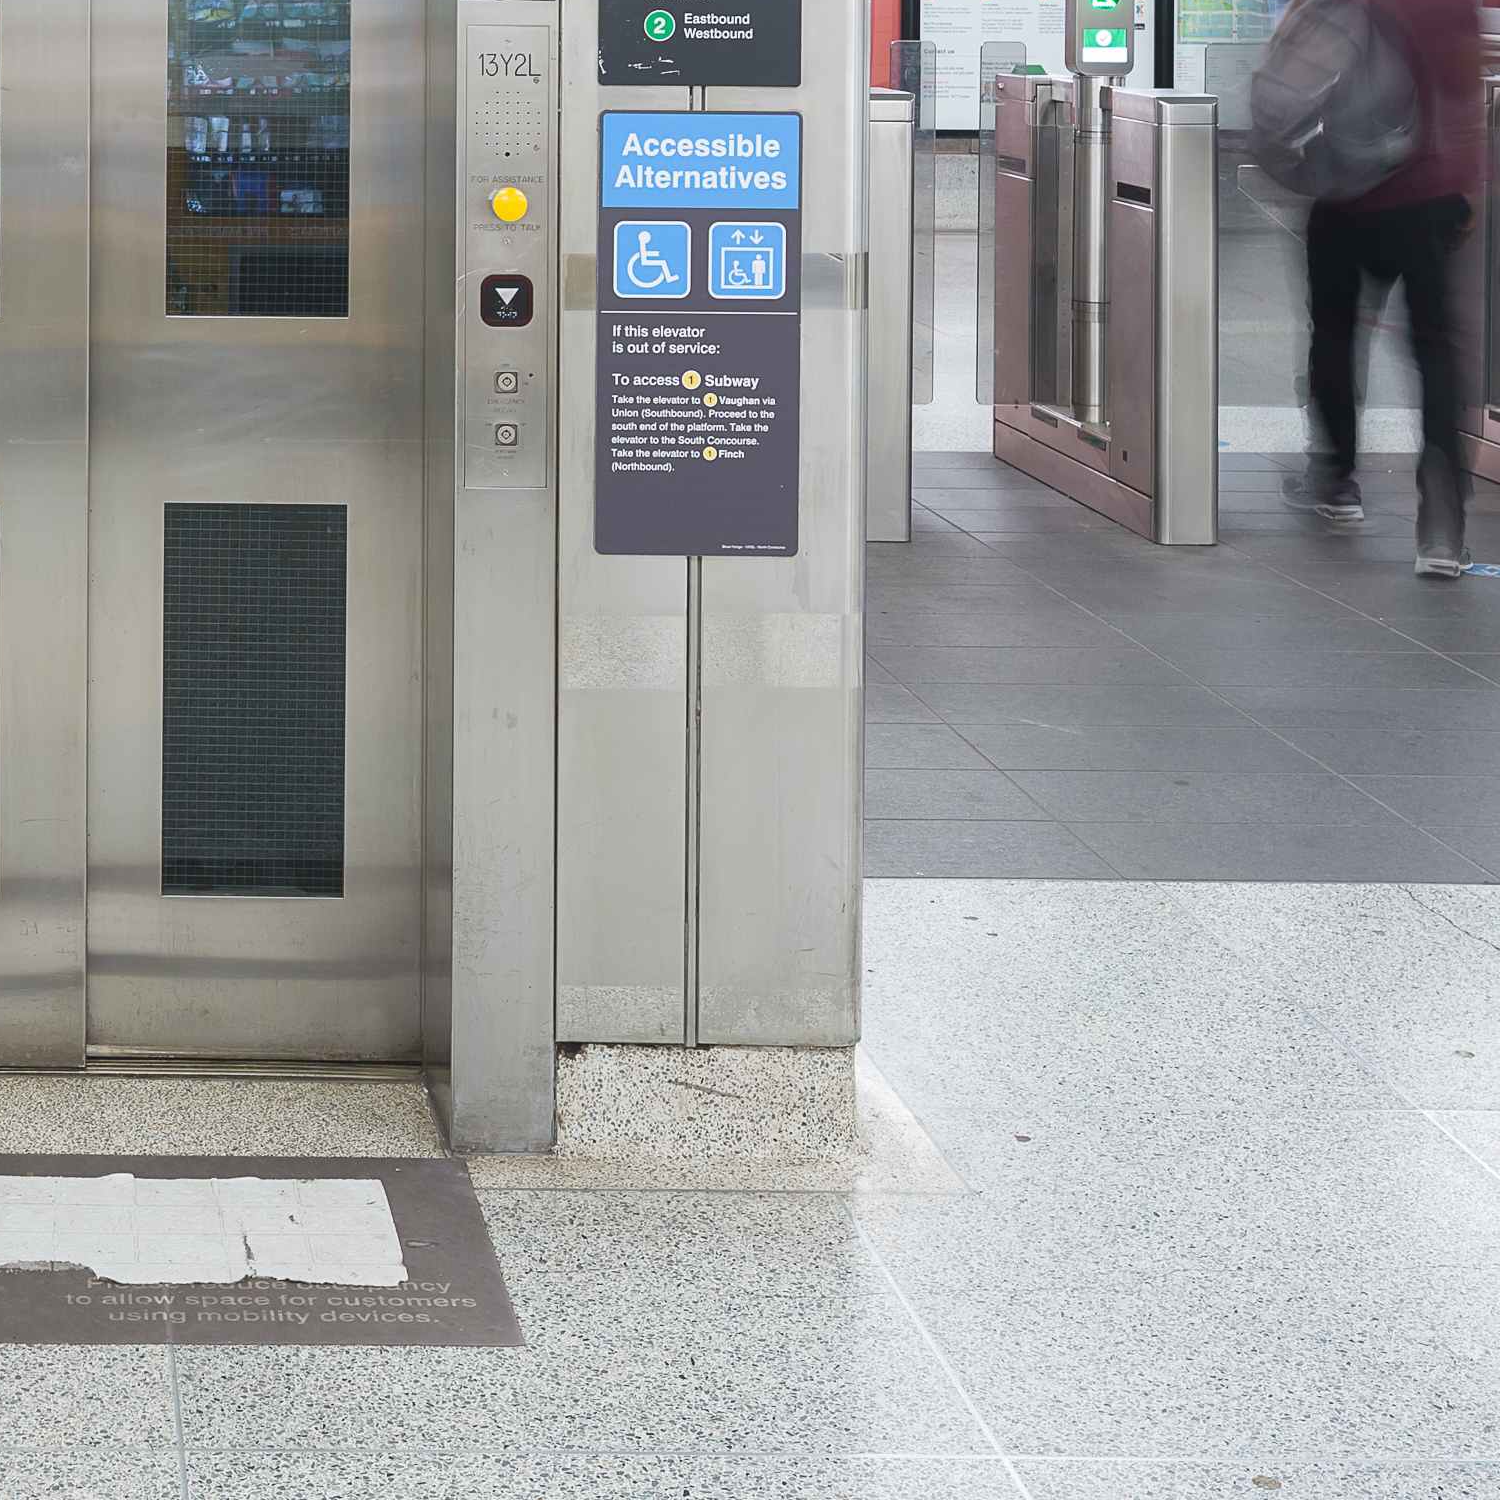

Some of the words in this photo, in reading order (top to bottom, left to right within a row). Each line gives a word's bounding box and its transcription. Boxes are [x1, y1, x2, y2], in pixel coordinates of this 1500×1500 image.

[684, 12, 751, 25] Eastbound
[653, 17, 666, 35] 2
[683, 27, 754, 40] Westbound
[478, 53, 541, 77] 13Y2L
[621, 132, 781, 158] Accessible
[614, 164, 787, 190] Alternatives
[612, 324, 622, 337] If
[624, 324, 649, 338] this
[651, 325, 706, 338] elevator
[612, 340, 624, 354] is
[626, 341, 650, 354] out
[651, 341, 667, 354] of
[668, 341, 721, 355] service:
[611, 373, 630, 386] To
[632, 375, 680, 386] access
[704, 374, 760, 391] Subway
[611, 394, 635, 404] Take
[635, 395, 652, 405] the
[652, 395, 690, 405] elevator
[690, 396, 701, 405] to
[718, 395, 761, 407] Vaughan
[761, 396, 776, 406] via
[611, 408, 639, 418] Union
[641, 408, 707, 420] (Southbound).
[708, 409, 747, 419] Proceed
[748, 409, 759, 419] to
[759, 409, 775, 419] the
[611, 421, 638, 431] south
[639, 421, 657, 431] end
[658, 421, 669, 431] of
[670, 422, 686, 432] the
[686, 422, 728, 434] platform.
[729, 422, 753, 432] Take
[753, 423, 769, 432] the
[611, 434, 649, 445] elevator
[649, 435, 660, 445] to
[660, 435, 677, 445] the
[677, 435, 705, 445] South
[706, 435, 760, 446] Concourse.
[610, 448, 634, 458] Take
[635, 448, 651, 458] the
[652, 448, 690, 458] elevator
[690, 449, 701, 459] to
[718, 449, 745, 459] Finch
[611, 461, 675, 473] (Northbound).
[65, 1293, 93, 1305] to
[102, 1293, 175, 1306] allow
[185, 1294, 271, 1309] space
[279, 1293, 317, 1306] for
[327, 1295, 478, 1308] customers
[108, 1310, 187, 1325] using
[197, 1309, 309, 1325] mobility
[319, 1310, 440, 1324] devices.
